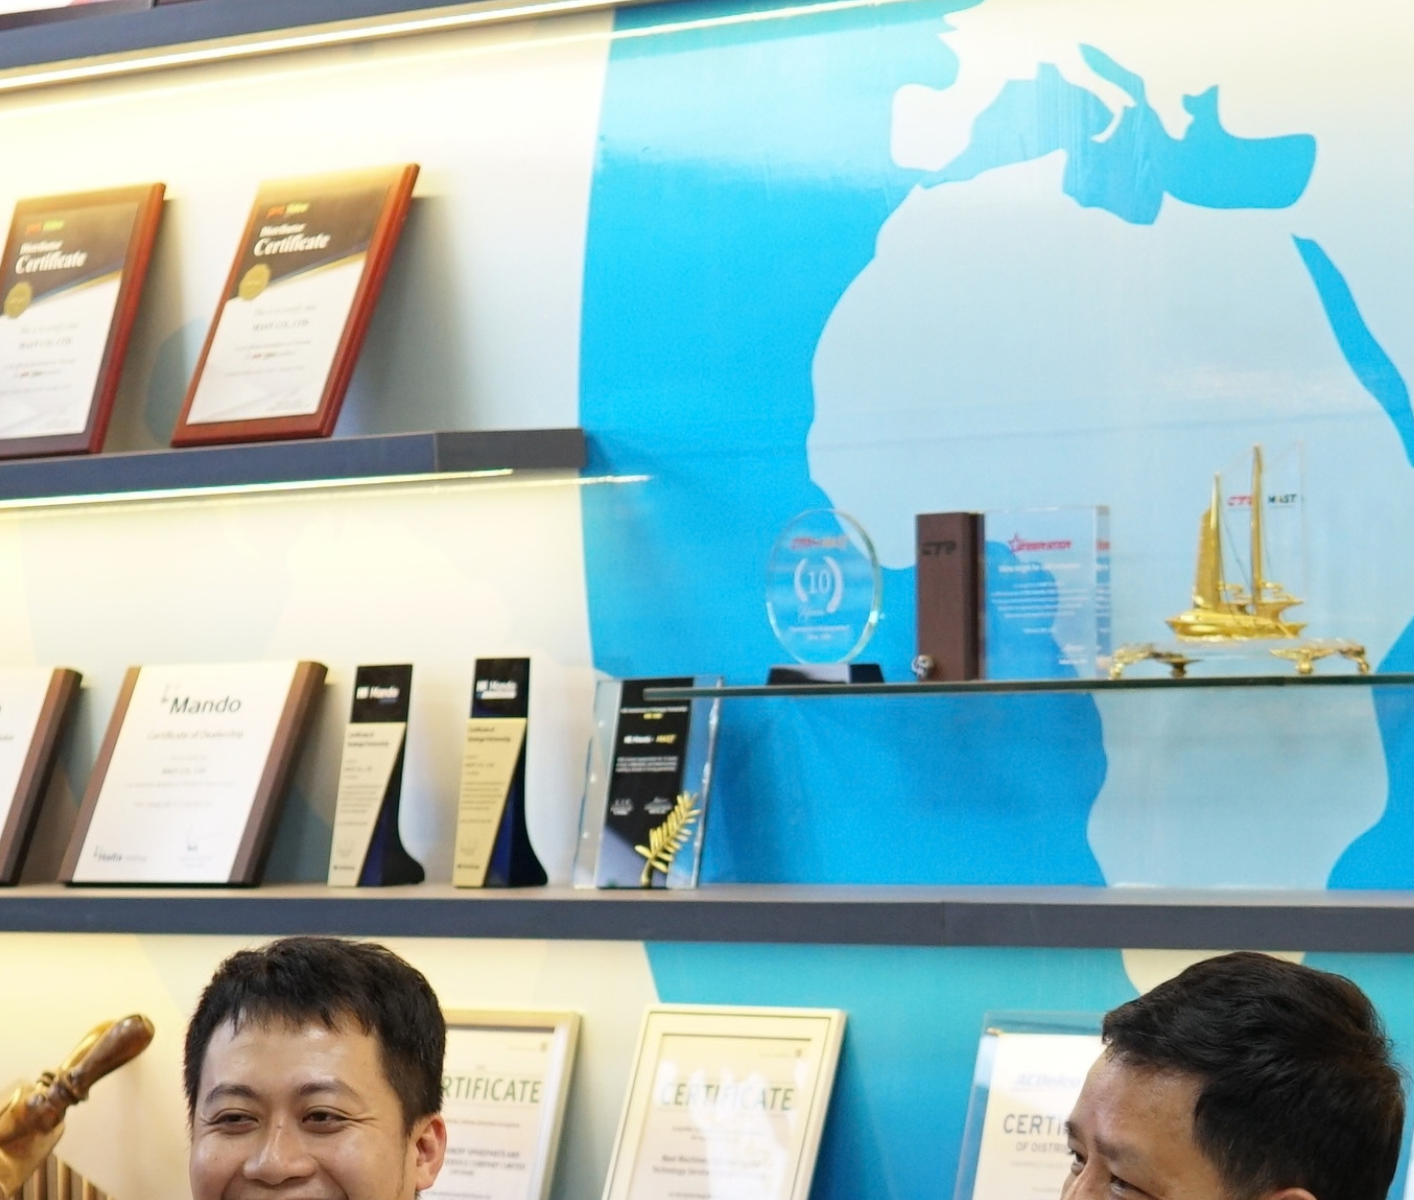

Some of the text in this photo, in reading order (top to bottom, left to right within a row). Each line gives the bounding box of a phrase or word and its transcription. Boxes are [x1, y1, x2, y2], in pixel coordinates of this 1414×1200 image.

[253, 231, 331, 257] Certificate
[15, 250, 88, 275] Certificate
[169, 696, 243, 716] Mando
[660, 1082, 795, 1111] CERTIFICATE
